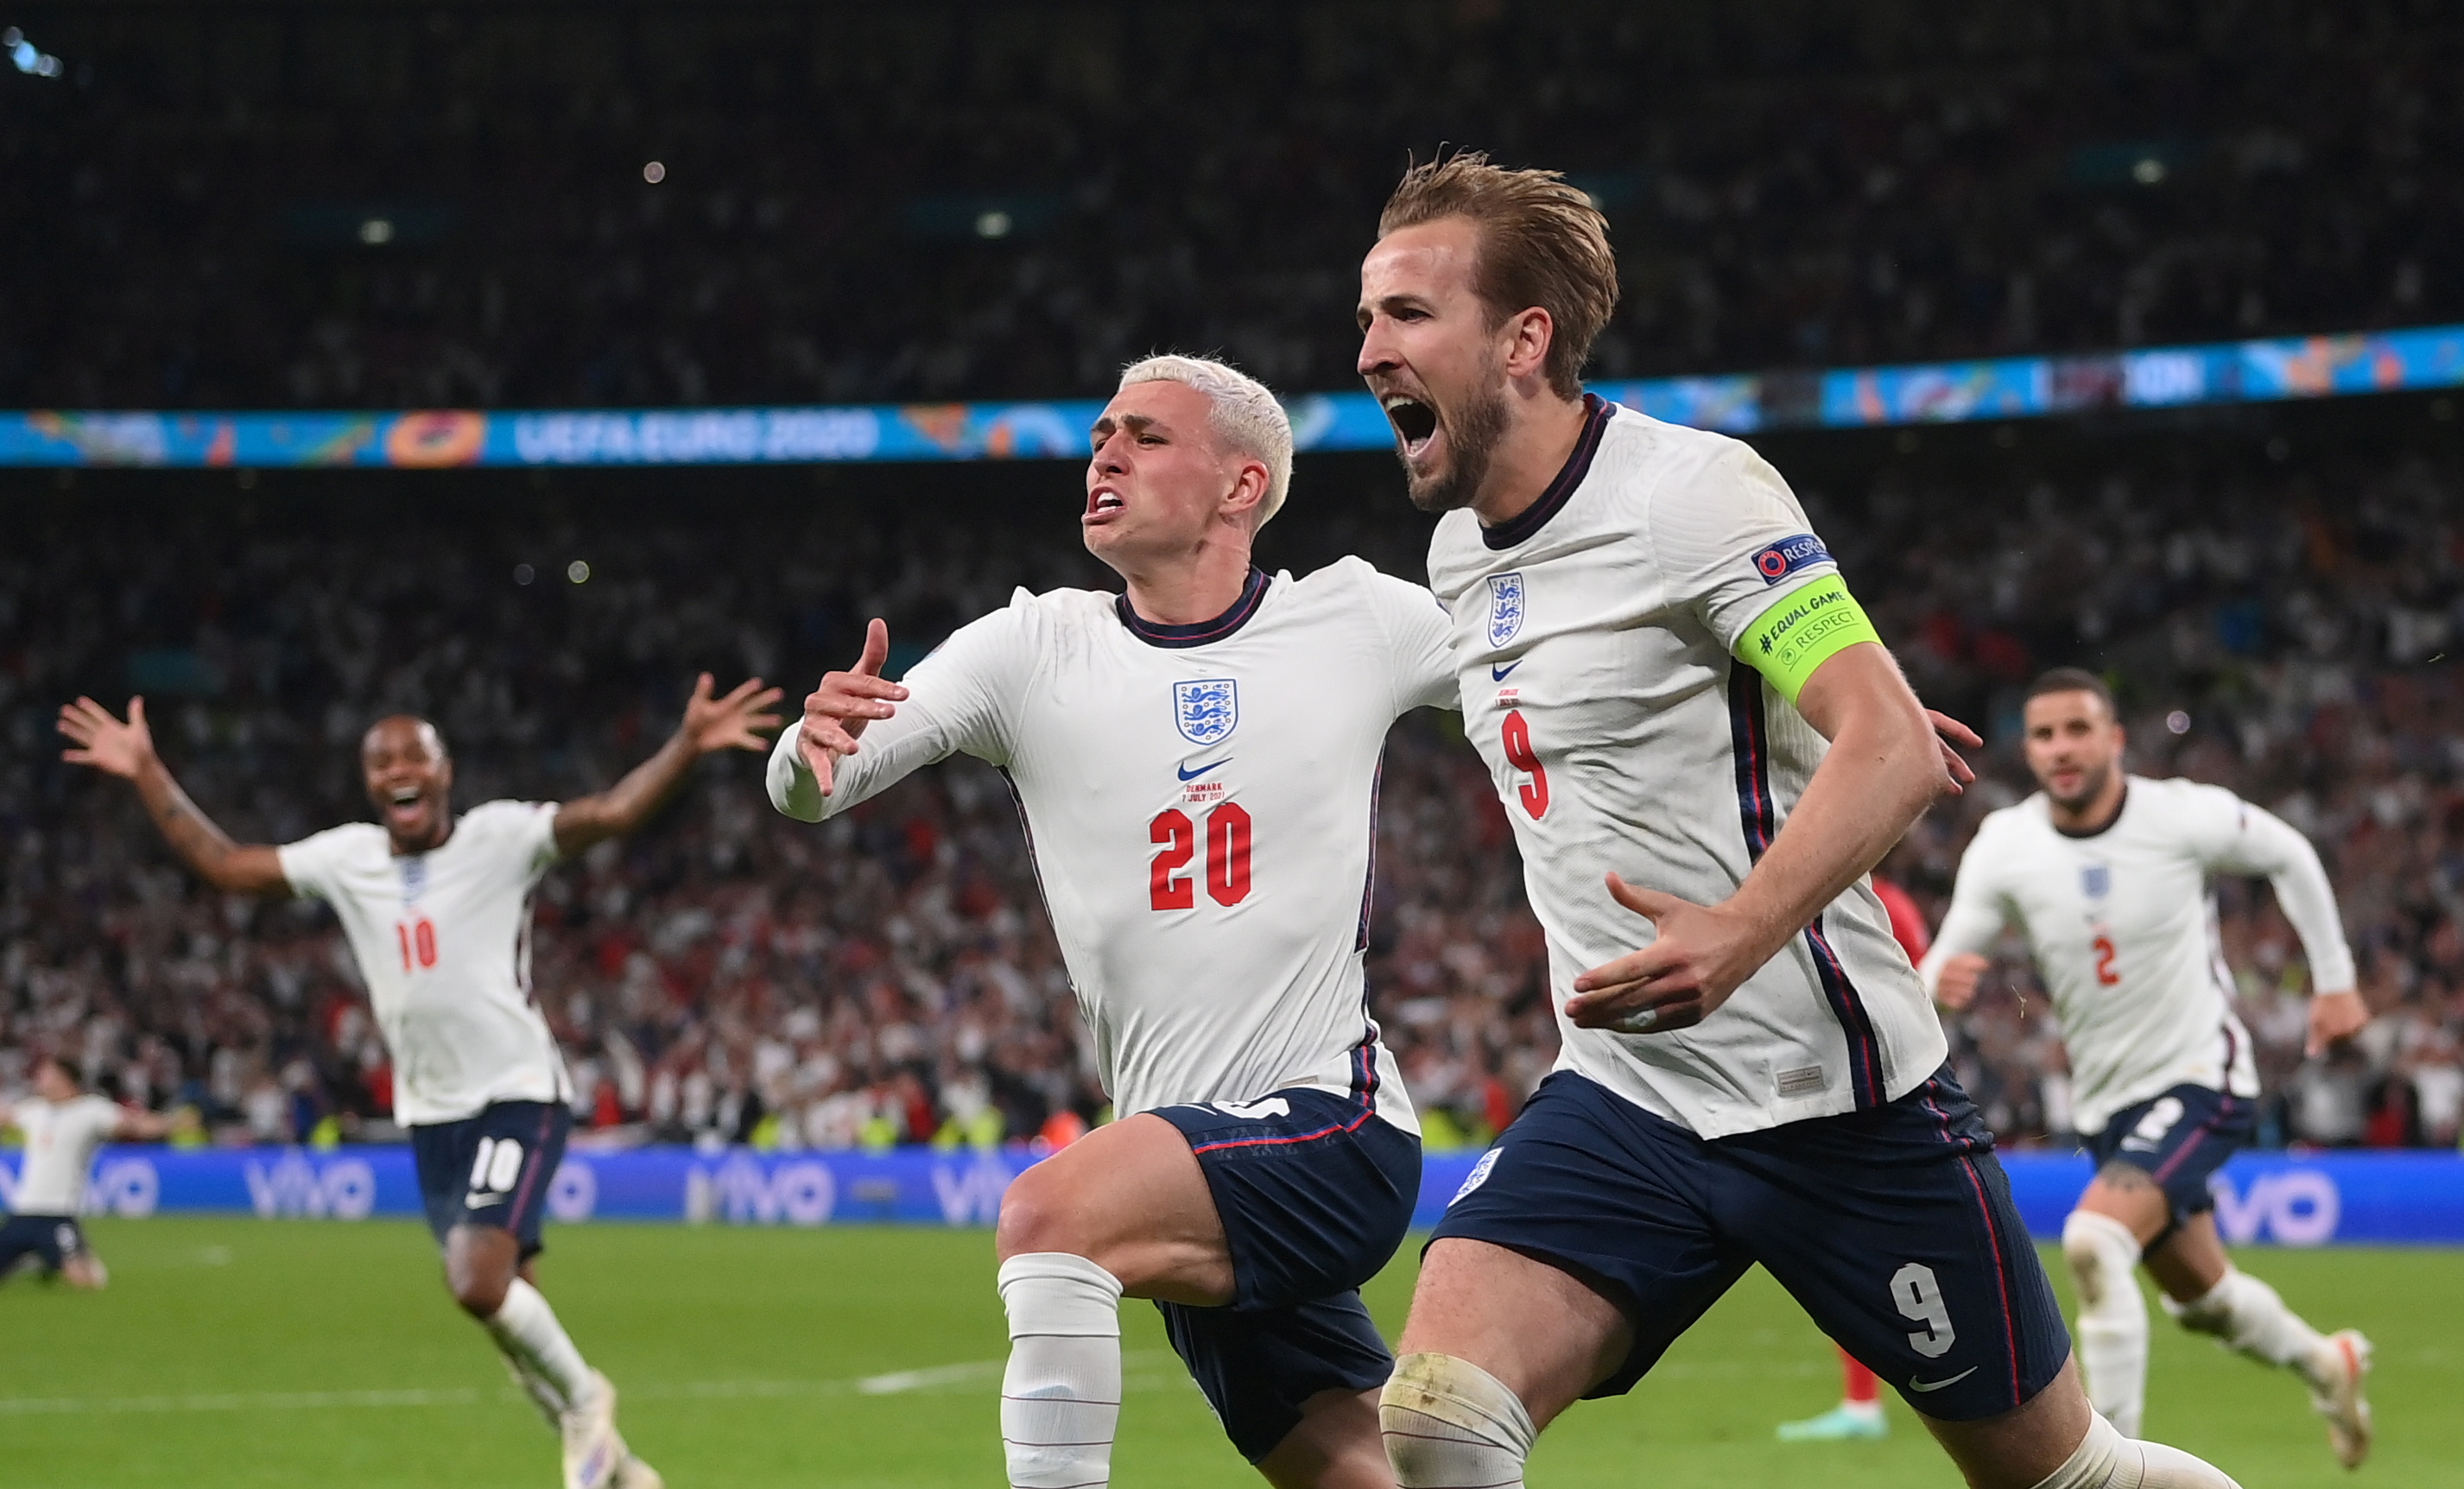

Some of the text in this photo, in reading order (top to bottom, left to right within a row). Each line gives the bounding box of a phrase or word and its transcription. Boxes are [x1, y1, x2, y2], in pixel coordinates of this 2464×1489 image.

[1783, 542, 1826, 562] RESPE
[1759, 591, 1846, 656] #EQUAL GAME
[1796, 611, 1855, 648] RESPECT
[1186, 783, 1223, 793] DENMARK
[1501, 709, 1549, 821] 9
[1188, 793, 1207, 802] JULY
[1149, 802, 1251, 911] 20
[396, 919, 437, 973] 10
[2092, 935, 2122, 986] 2
[469, 1135, 524, 1192] 10
[1889, 1262, 1956, 1359] 9
